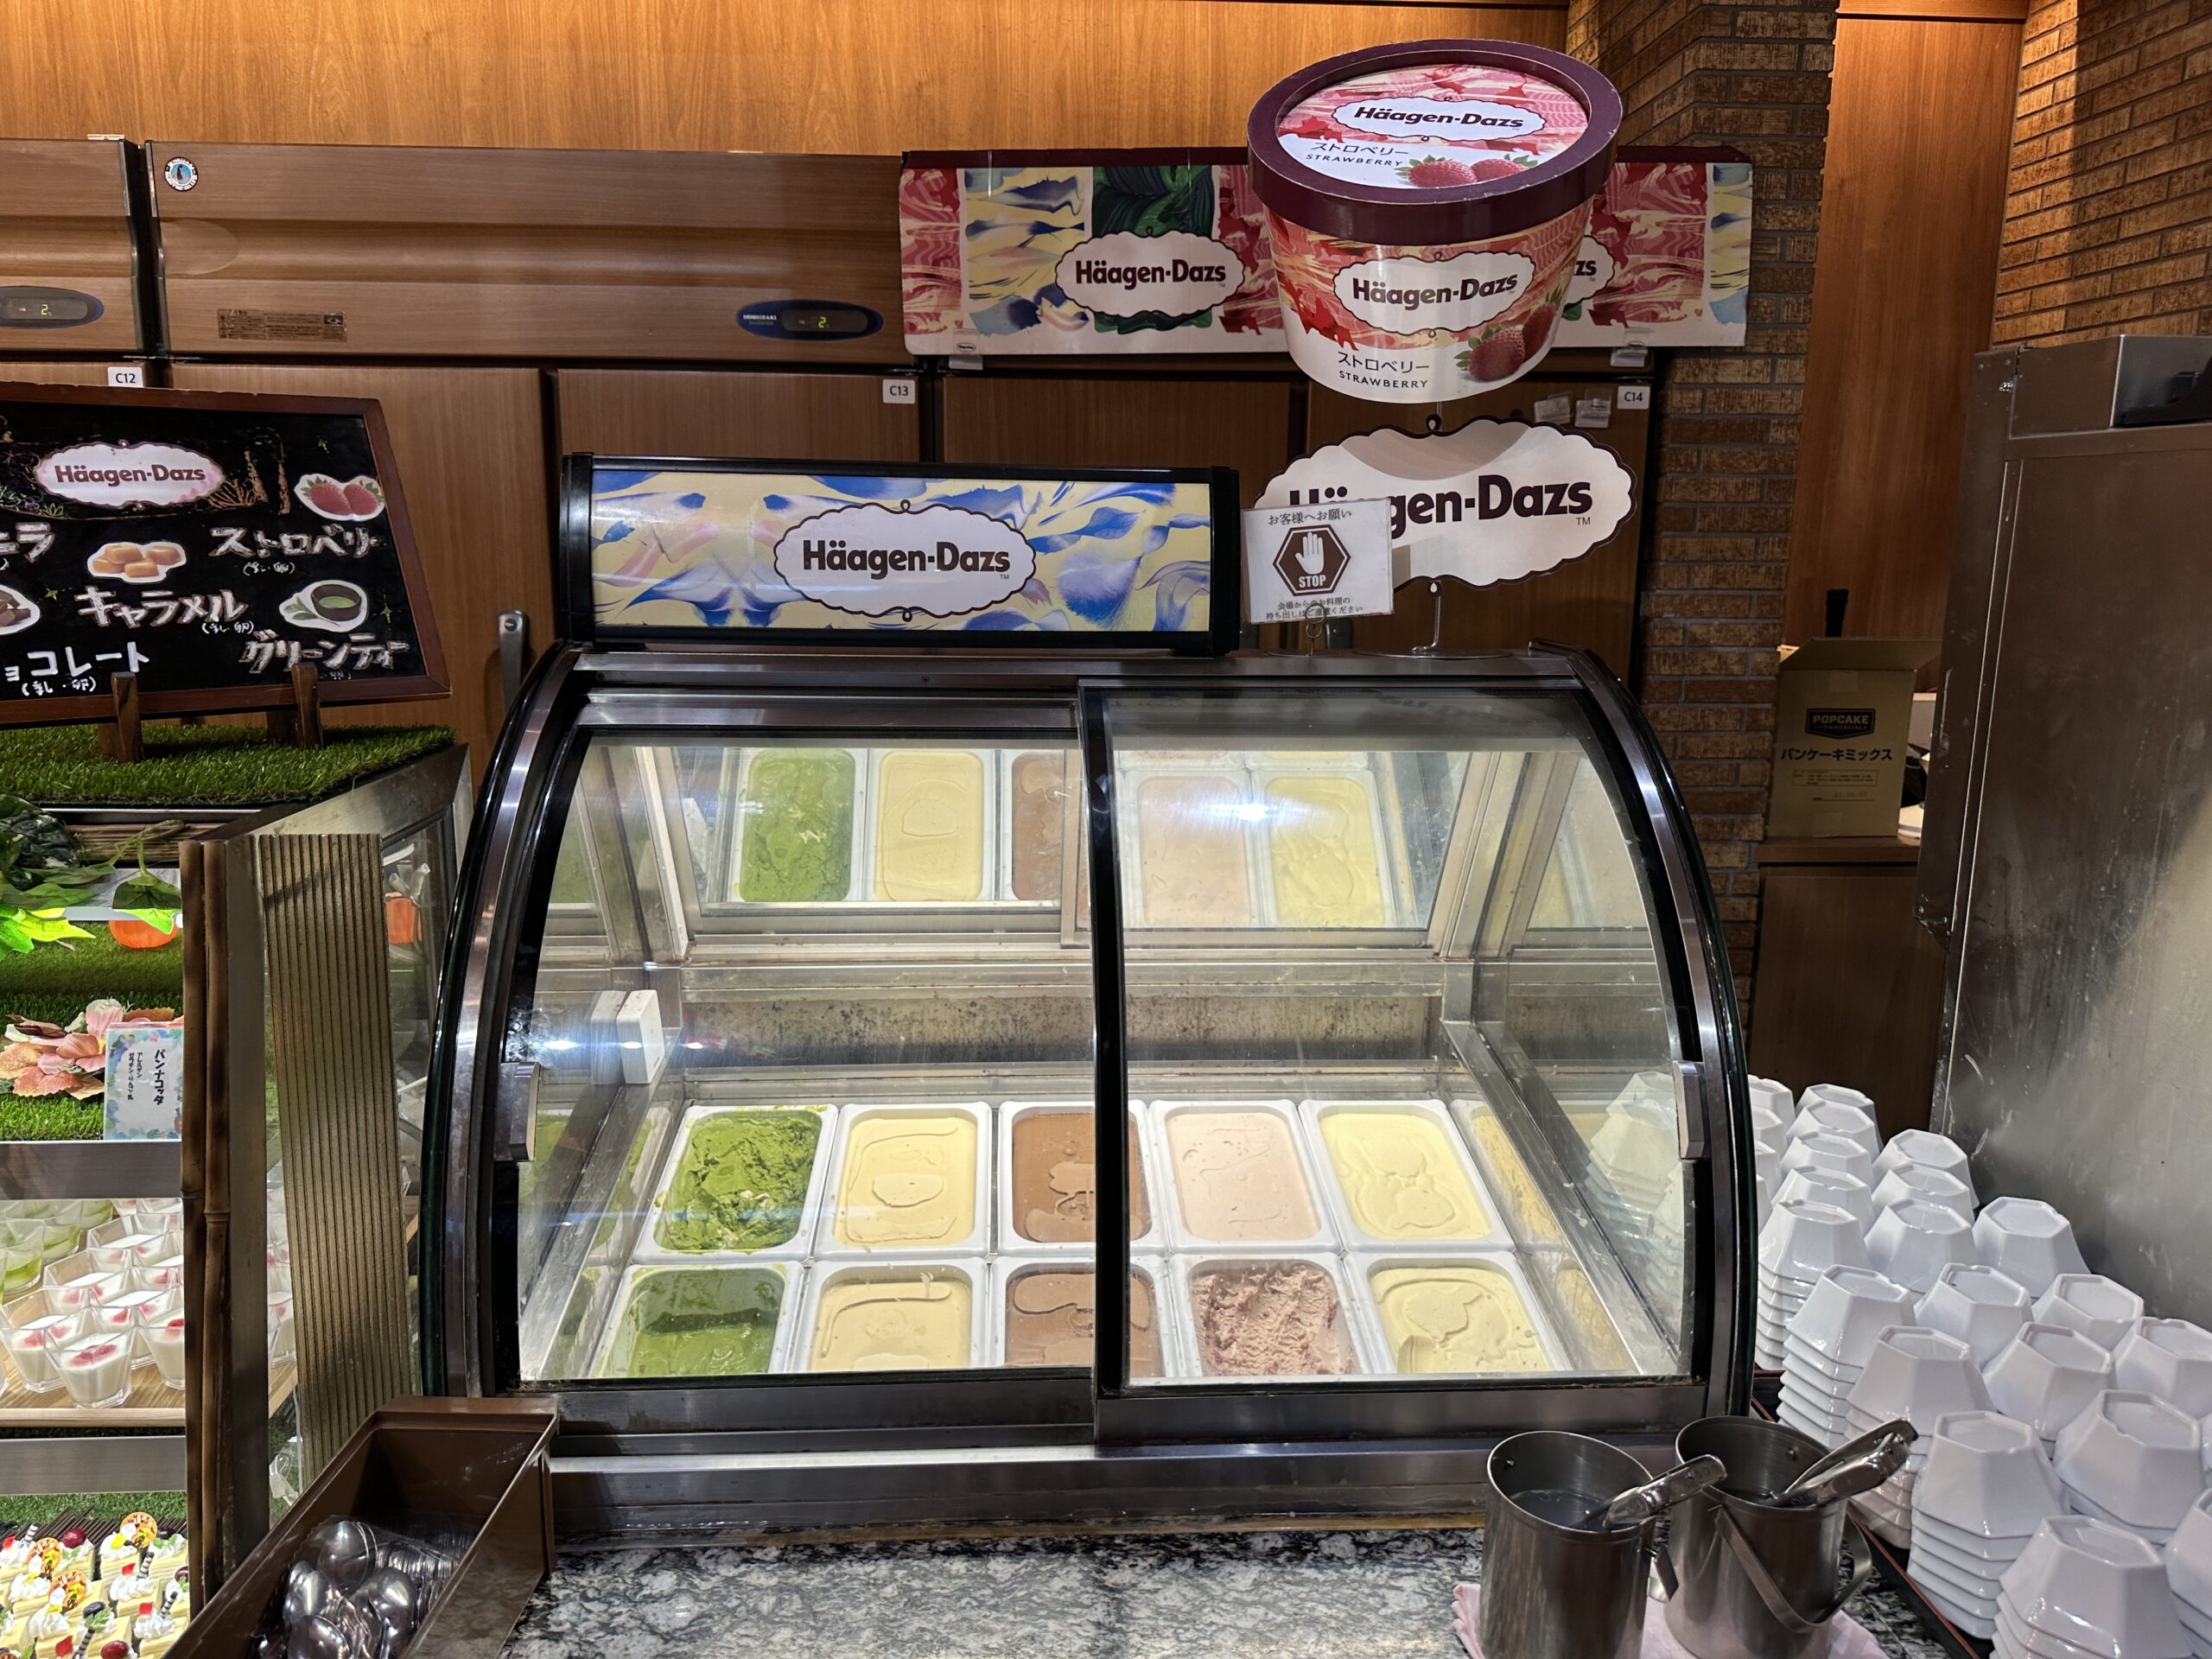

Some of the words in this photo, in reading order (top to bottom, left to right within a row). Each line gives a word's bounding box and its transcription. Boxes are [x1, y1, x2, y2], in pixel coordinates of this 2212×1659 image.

[1354, 106, 1523, 129] Häagen-Dazs
[1312, 141, 1409, 156] ストロベリー
[1306, 154, 1404, 168] STRAWBERRY
[1075, 259, 1227, 289] Häagen-Dazs
[1351, 273, 1518, 311] Häagen-Dazs
[41, 303, 48, 315] 2
[817, 315, 827, 328] 2
[1337, 351, 1431, 374] ストロベリー
[115, 372, 137, 384] C12
[1338, 370, 1429, 389] STRAWBERRY
[889, 385, 909, 397] C13
[1624, 391, 1643, 403] C14
[54, 463, 207, 486] Häagen-Dazs
[1289, 474, 1593, 540] gen-Dazs
[1268, 508, 1352, 526] お客様へお願い
[802, 539, 1011, 580] Häagen-Dazs
[1298, 575, 1326, 588] STOP
[73, 585, 250, 629] キャラメル
[1813, 715, 1869, 725] POPCAKE
[1781, 747, 1893, 761] パンケーキミックス
[154, 1048, 166, 1105] パンナコッタ
